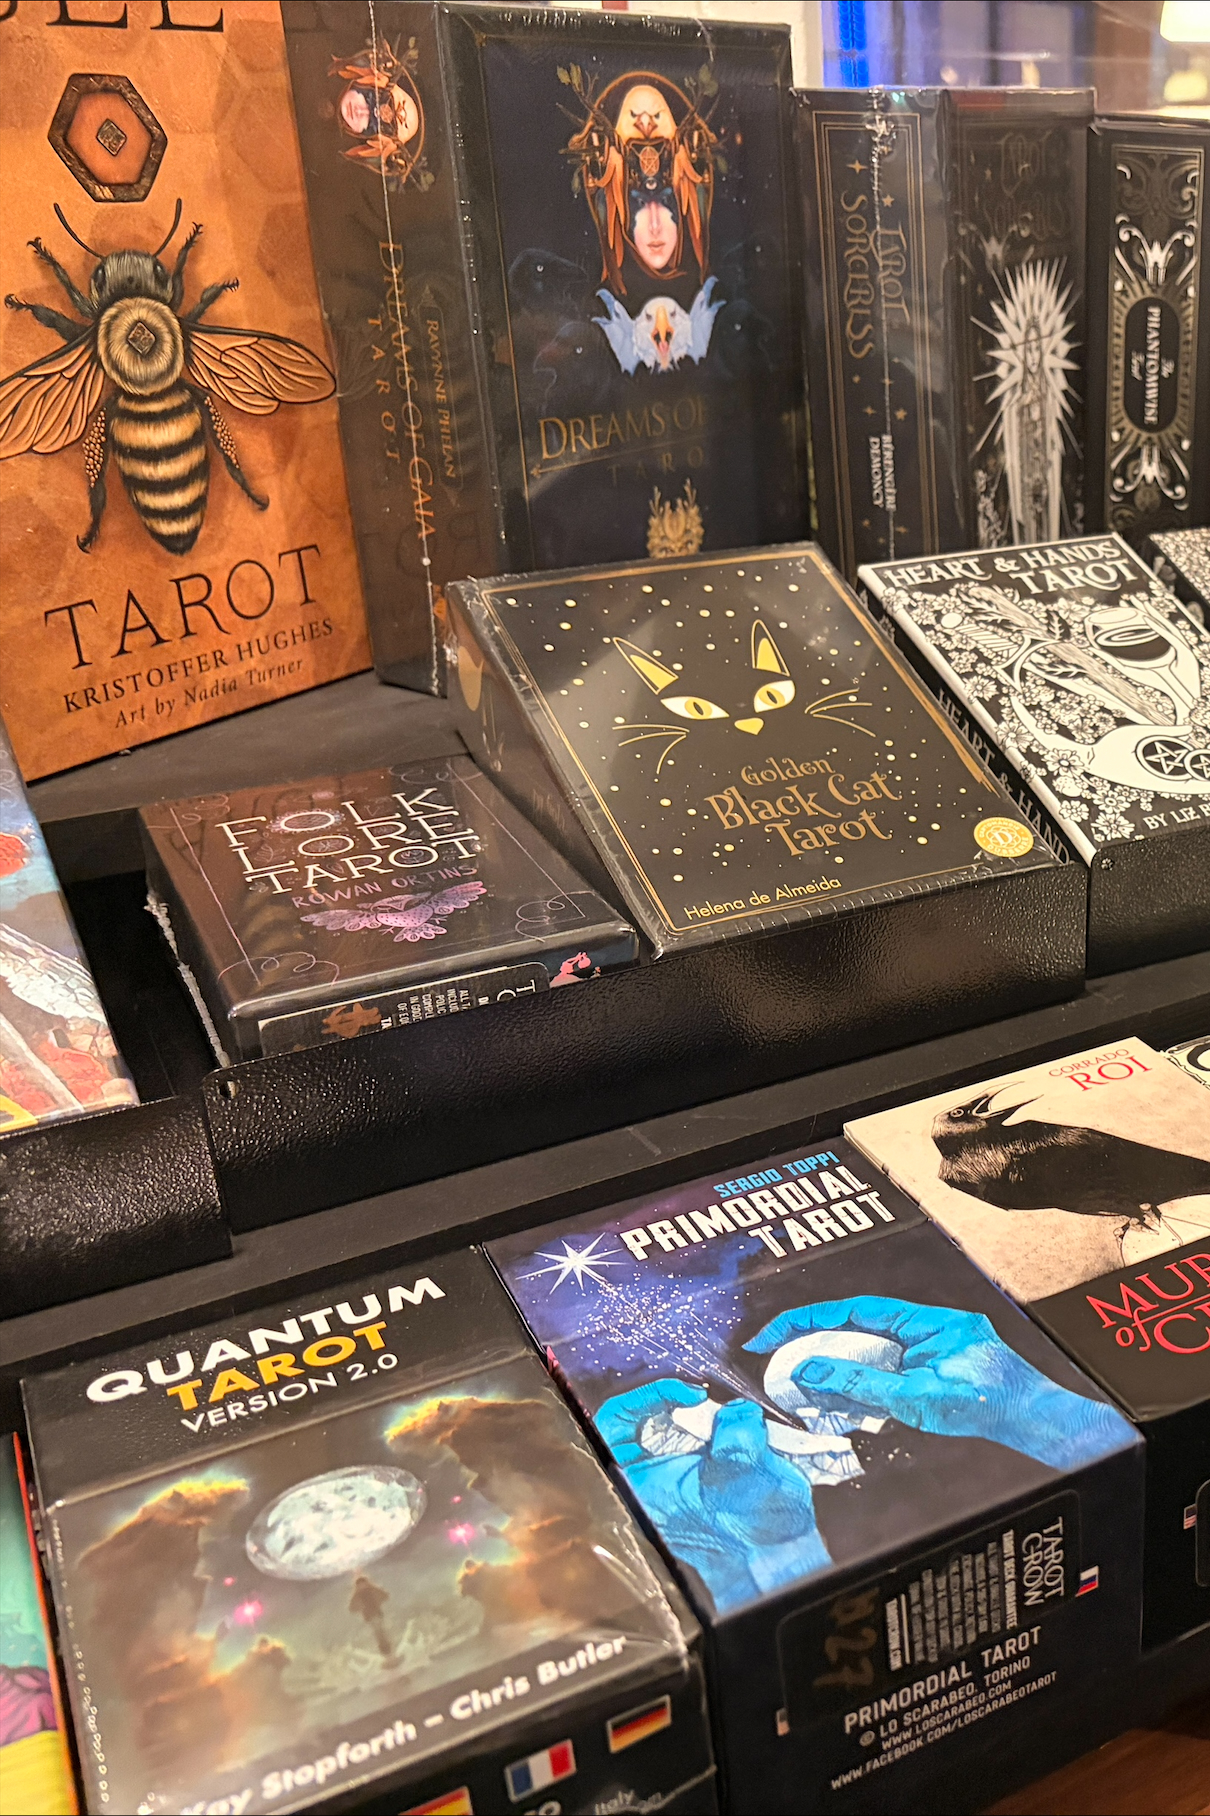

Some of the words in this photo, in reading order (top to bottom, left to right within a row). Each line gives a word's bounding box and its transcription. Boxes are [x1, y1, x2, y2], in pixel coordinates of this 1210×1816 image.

[841, 189, 875, 359] SORCERESS
[869, 227, 910, 324] TAROT
[378, 241, 418, 394] DREAMS
[1143, 305, 1161, 425] PHANTOMWISE
[401, 401, 425, 450] OF
[437, 408, 456, 477] PHELAN
[538, 402, 667, 460] DREAMS
[408, 455, 436, 538] GAIA
[884, 557, 992, 588] HEART
[993, 555, 1020, 573] &
[1020, 540, 1122, 570] HANDS
[1010, 558, 1138, 595] TAROT
[44, 544, 321, 669] TAROT
[63, 649, 228, 713] KRISTOFFER
[236, 617, 334, 661] HUGHES
[115, 708, 145, 729] Art
[155, 698, 176, 718] by
[183, 679, 238, 707] Nadia
[245, 659, 303, 686] Turner
[704, 783, 842, 830] Black
[827, 770, 902, 806] Cat
[740, 756, 835, 787] Golden
[938, 686, 995, 767] HEART
[999, 772, 1013, 793] &
[1018, 789, 1070, 866] HAND
[215, 787, 453, 848] FOLK
[233, 811, 474, 874] LORE
[764, 808, 892, 856] Tarot
[1143, 813, 1168, 830] BY
[1170, 806, 1201, 824] LIZ
[245, 836, 479, 894] TAROT
[292, 881, 382, 908] ROWAN
[684, 897, 745, 920] Helena
[749, 889, 771, 906] de
[775, 876, 842, 901] Almeida
[1048, 1048, 1129, 1077] CORRADO
[1065, 1055, 1153, 1092] ROI
[713, 1168, 784, 1198] SERGIO
[782, 1150, 840, 1176] TOPPI
[620, 1165, 872, 1261] PRIMORDIAL
[748, 1190, 896, 1259] TAROT
[85, 1276, 447, 1403] QUANTUM
[1115, 1306, 1152, 1352] of
[166, 1320, 388, 1411] TAROT
[180, 1371, 339, 1433] VERSION
[346, 1353, 399, 1382] 2.0
[1021, 1528, 1043, 1611] CROW
[1042, 1514, 1063, 1604] TAROT
[844, 1660, 973, 1734] PRIMORDIAL
[981, 1625, 1042, 1668] TAROT
[880, 1719, 898, 1738] LO
[984, 1655, 1031, 1688] TORINO
[261, 1717, 418, 1800] Stopforth
[448, 1675, 531, 1722] Chris
[537, 1636, 628, 1684] Butler
[830, 1670, 1058, 1791] WWW.FACEBOOK.COM/LOSCARABEOTAROT
[881, 1680, 1012, 1751] WWW.LOSCARABEO.COM
